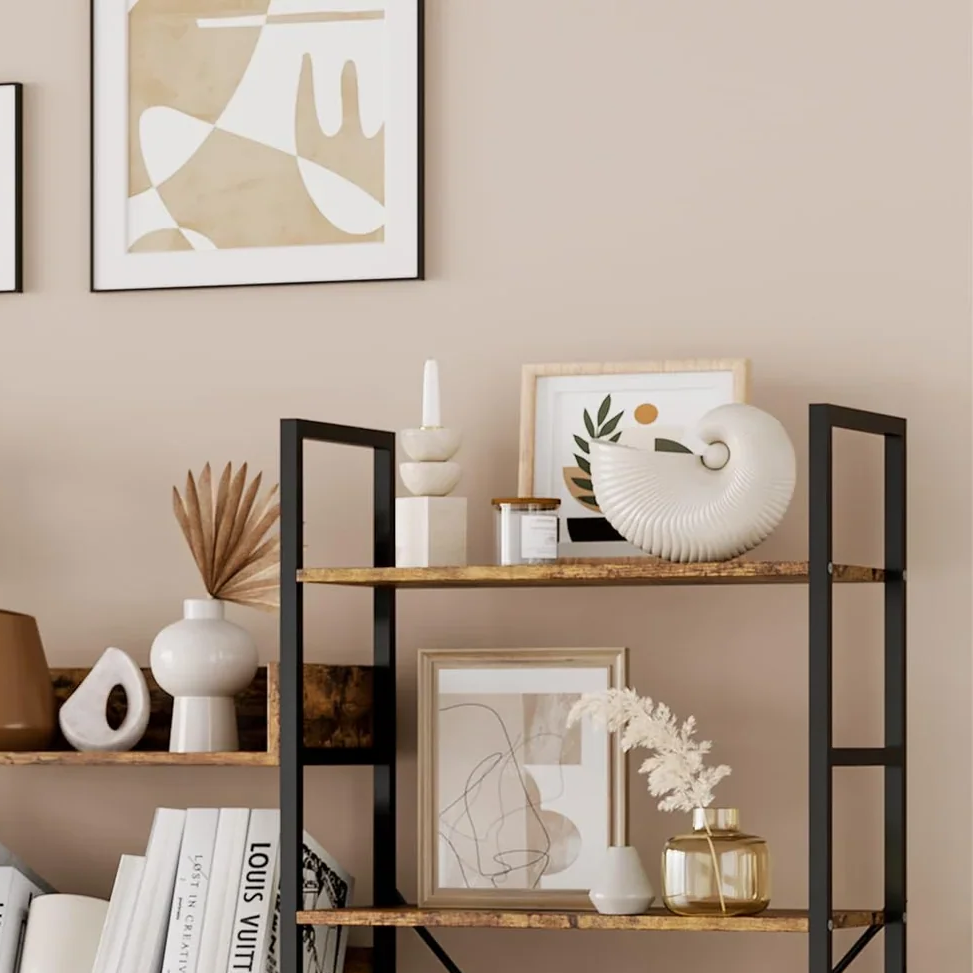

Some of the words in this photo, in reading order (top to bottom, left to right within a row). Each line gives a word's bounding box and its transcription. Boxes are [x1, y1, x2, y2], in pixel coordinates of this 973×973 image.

[189, 853, 203, 887] LOST
[243, 842, 271, 903] LOUIS
[187, 893, 197, 908] IN
